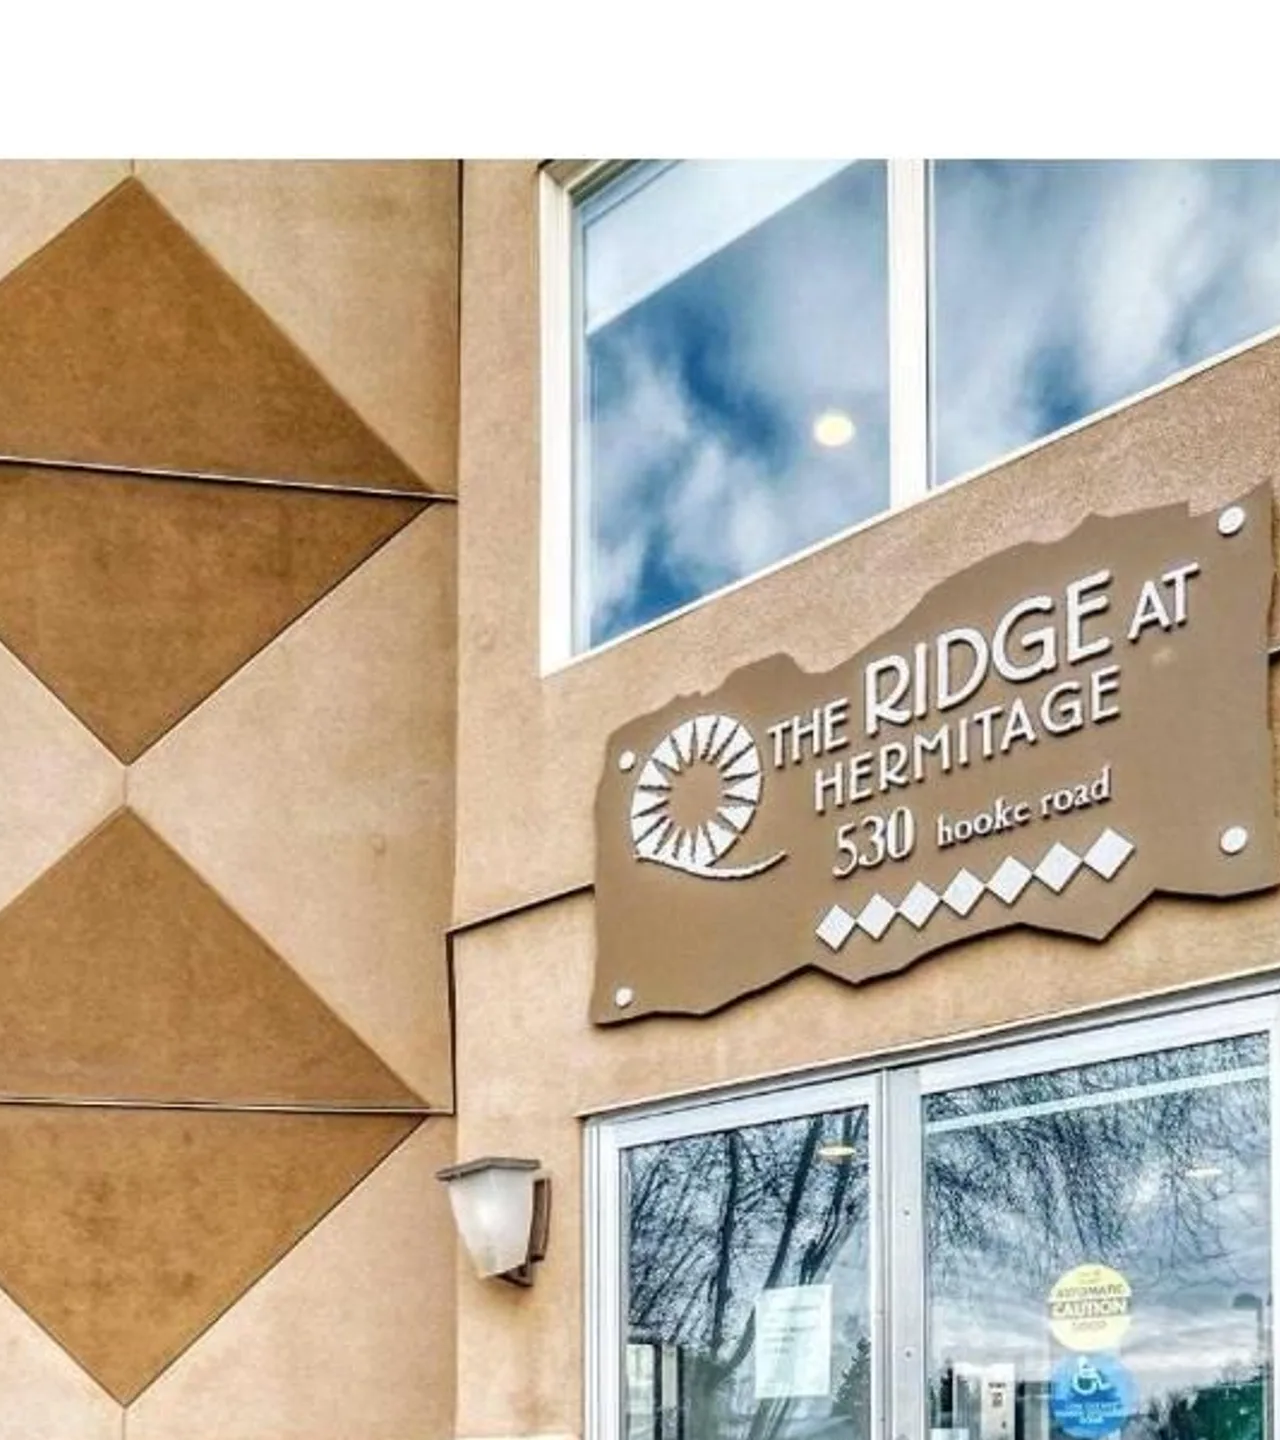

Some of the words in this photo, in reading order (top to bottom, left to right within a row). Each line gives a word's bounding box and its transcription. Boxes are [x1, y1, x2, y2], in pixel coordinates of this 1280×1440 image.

[767, 698, 849, 768] THE
[865, 568, 1112, 736] RIDGE
[1127, 561, 1199, 641] AT
[814, 665, 1121, 812] HERMITAGE
[832, 806, 916, 878] 530
[937, 797, 1032, 847] hooke
[1040, 763, 1112, 818] road
